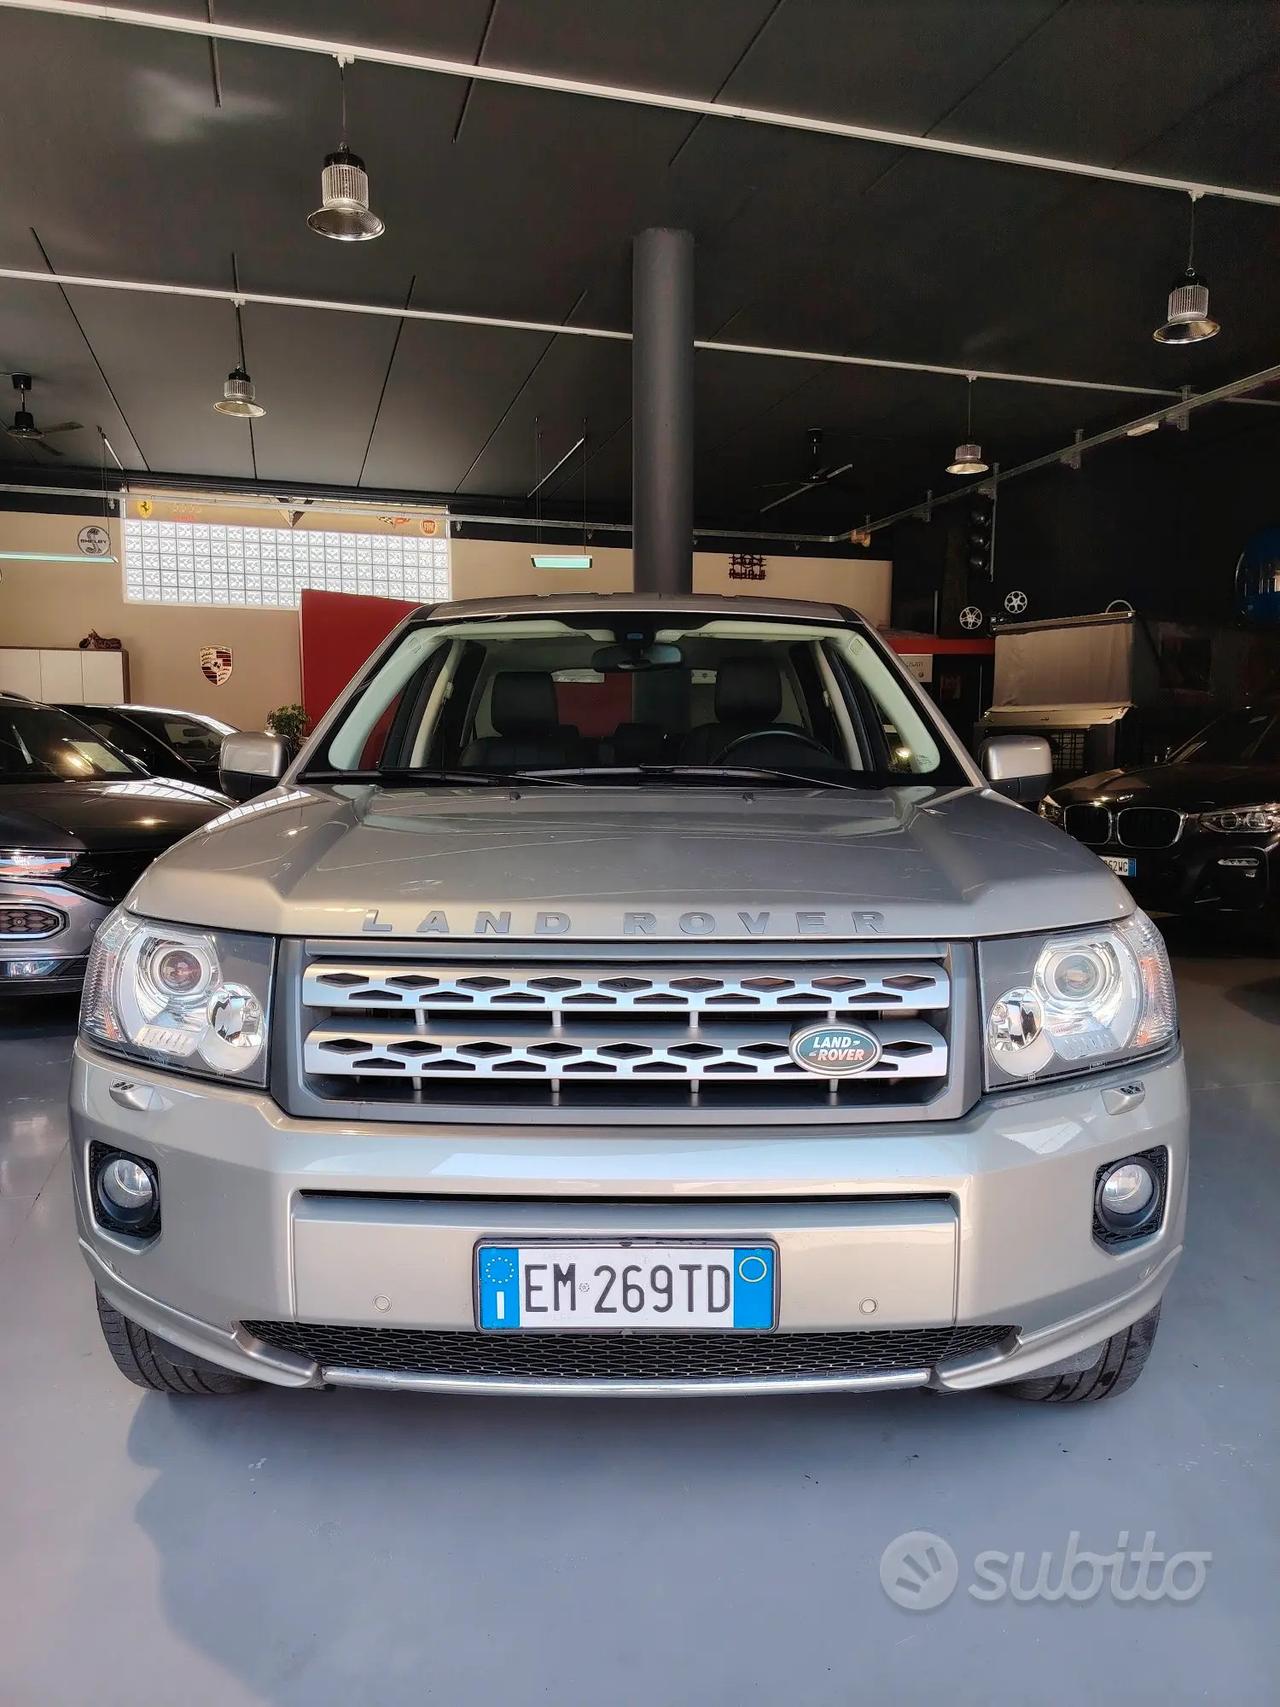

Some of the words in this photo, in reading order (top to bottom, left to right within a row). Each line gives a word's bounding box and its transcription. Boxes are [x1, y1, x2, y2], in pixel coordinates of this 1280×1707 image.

[362, 909, 571, 935] LAND
[623, 911, 889, 935] ROVER
[813, 1036, 852, 1049] LAND
[818, 1048, 865, 1061] ROVER
[524, 1262, 577, 1313] EM
[593, 1263, 731, 1314] 269TD
